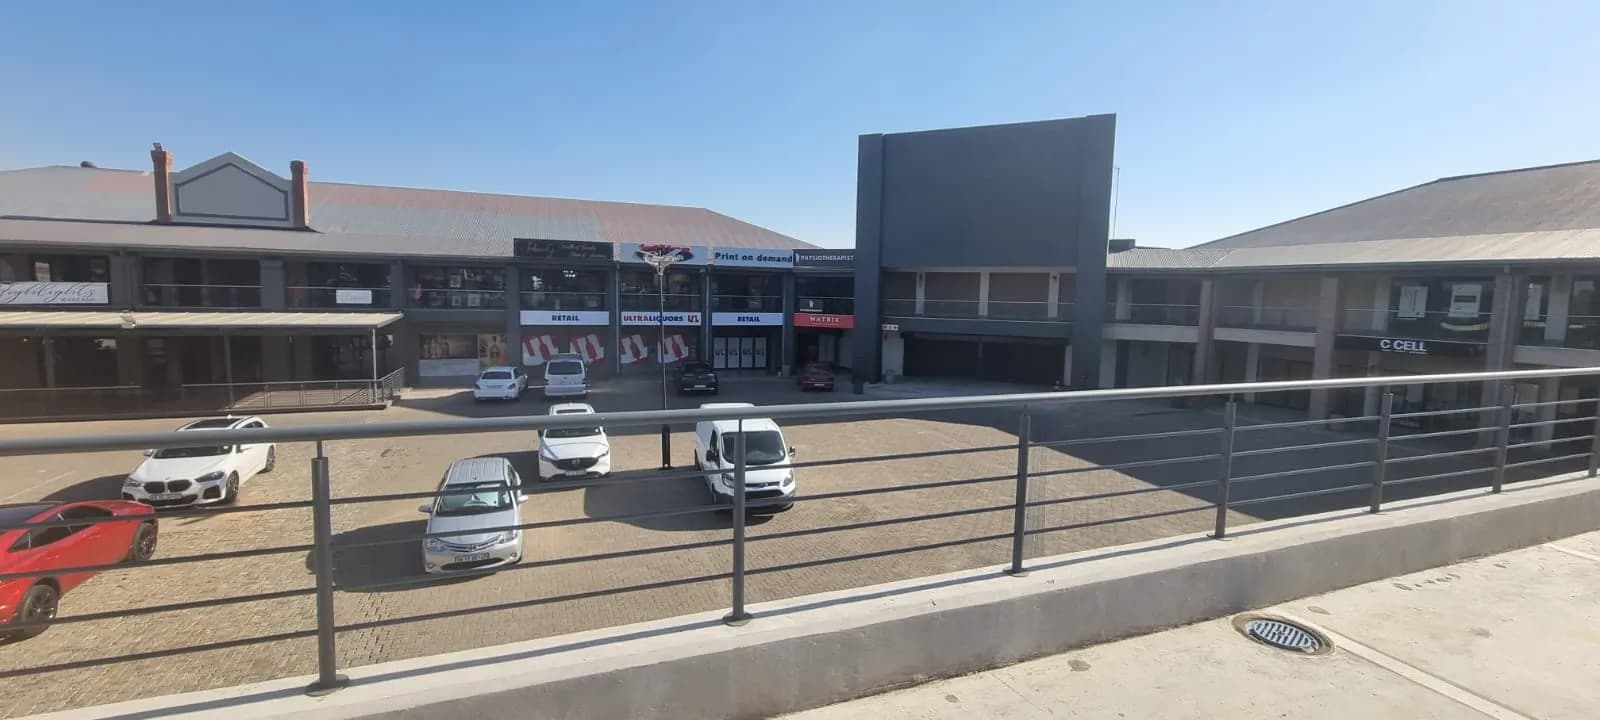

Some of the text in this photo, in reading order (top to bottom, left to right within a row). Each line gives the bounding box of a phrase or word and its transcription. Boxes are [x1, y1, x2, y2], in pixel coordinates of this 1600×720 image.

[715, 252, 738, 261] Print
[757, 254, 792, 263] demand
[800, 254, 855, 262] PHYSIOTHERAPIST
[551, 314, 580, 322] RETAIL
[1380, 339, 1428, 351] C CELL
